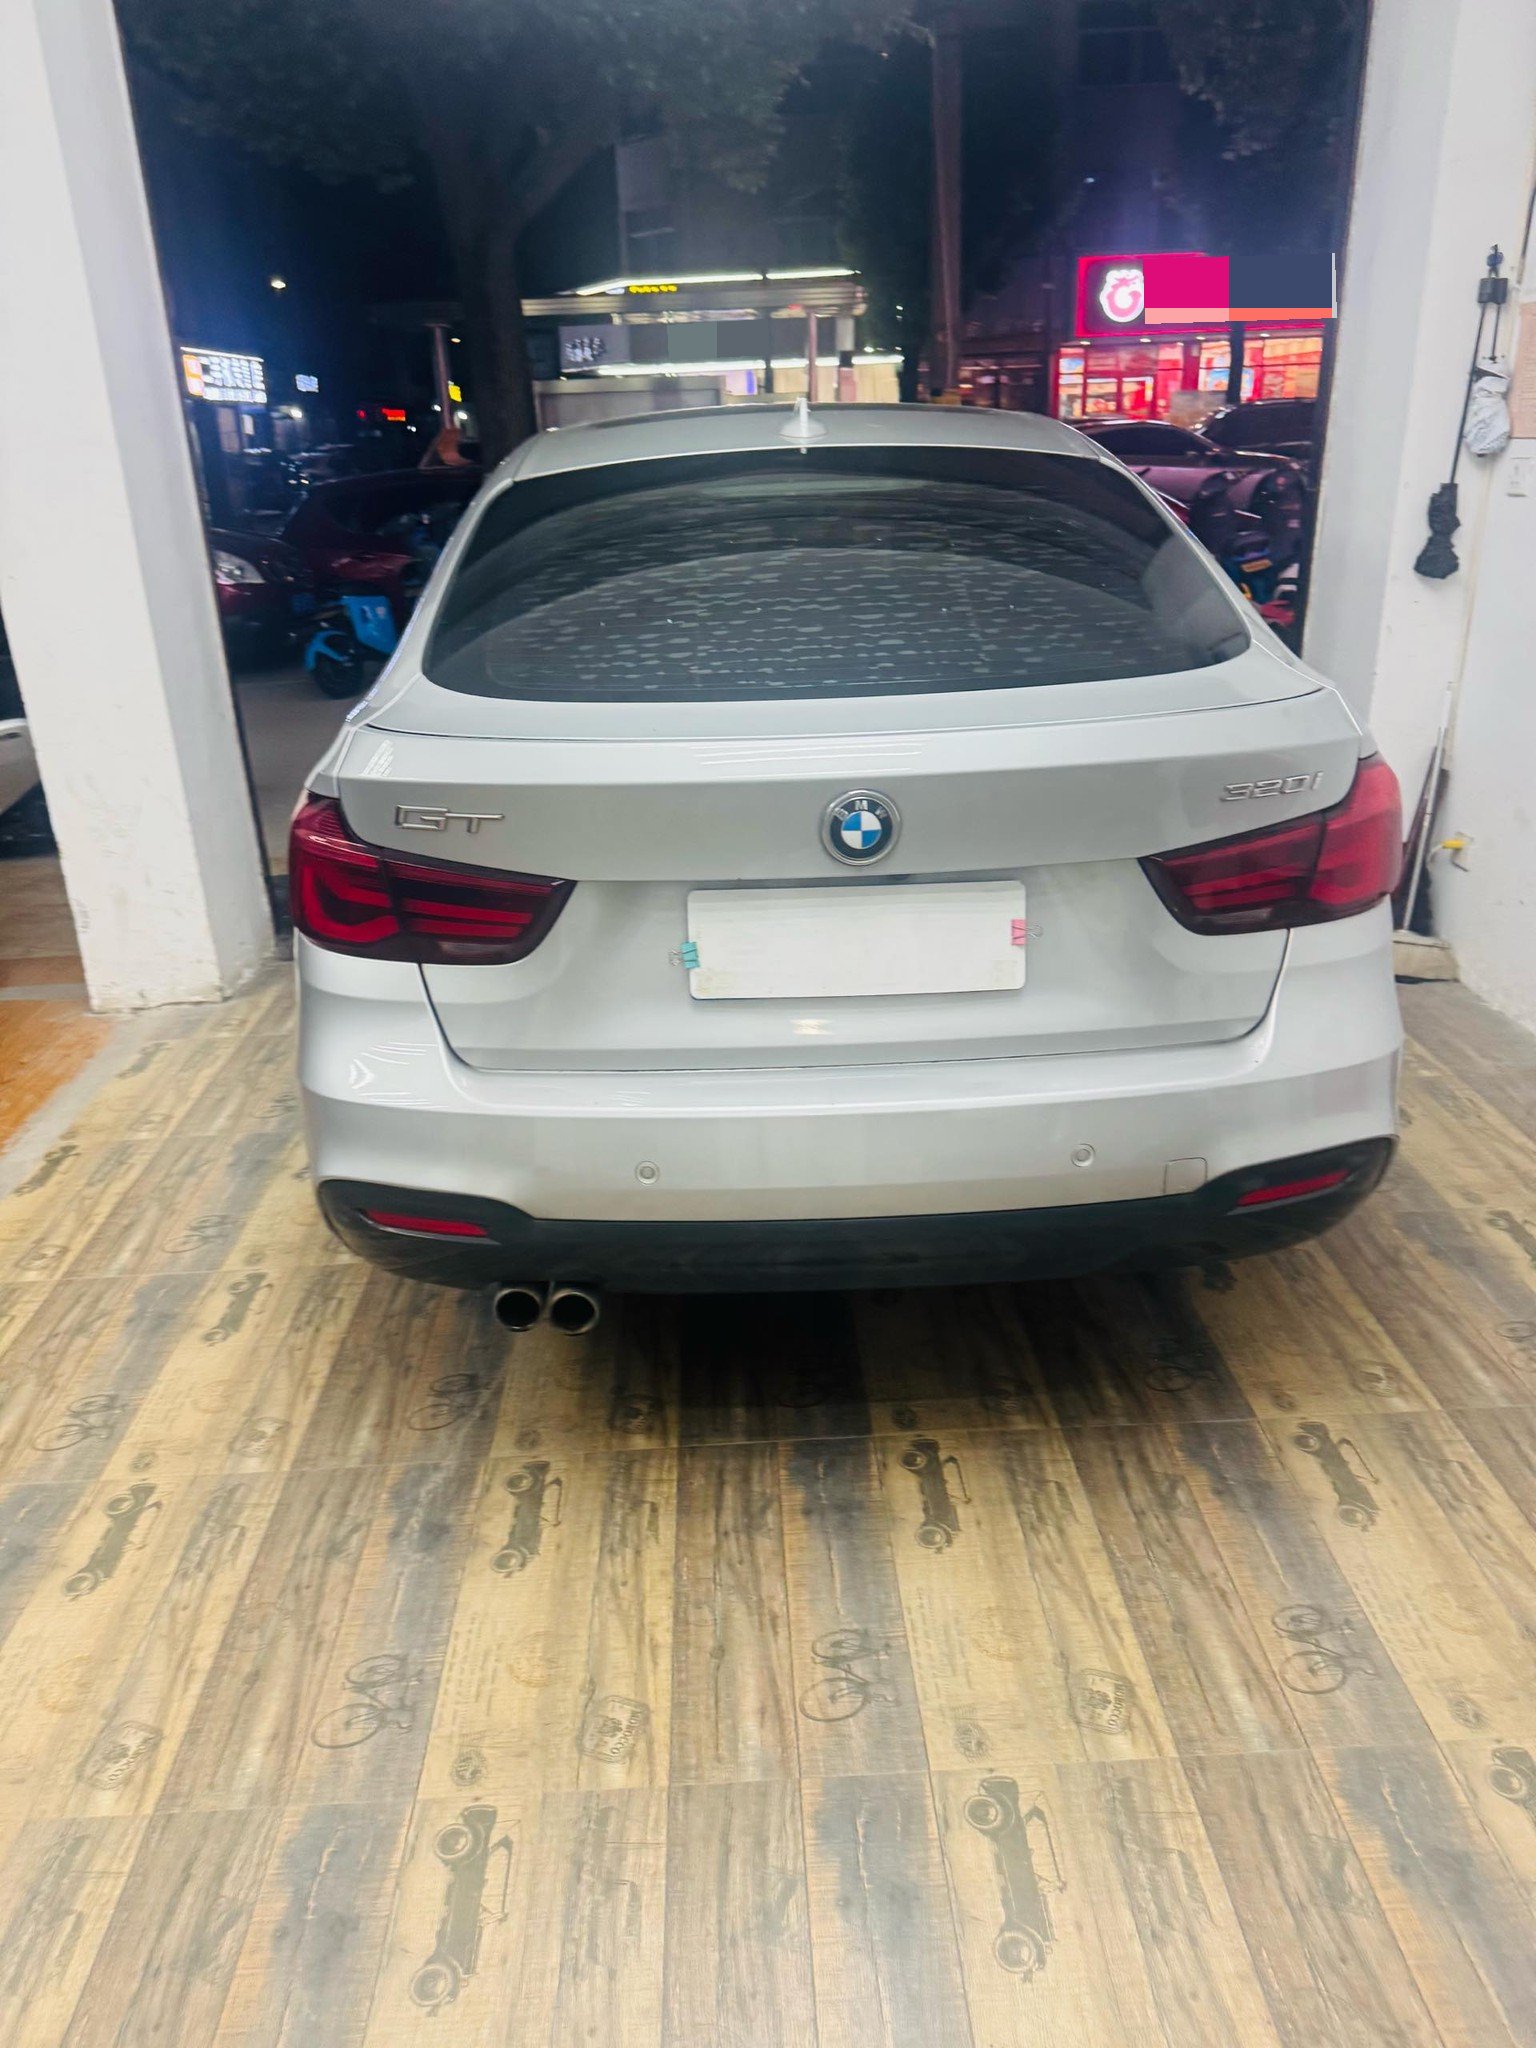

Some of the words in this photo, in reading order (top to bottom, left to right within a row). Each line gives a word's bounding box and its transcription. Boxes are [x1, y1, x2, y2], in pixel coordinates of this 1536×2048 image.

[1220, 771, 1324, 802] 320i
[395, 804, 504, 833] GT
[832, 799, 888, 820] BMW
